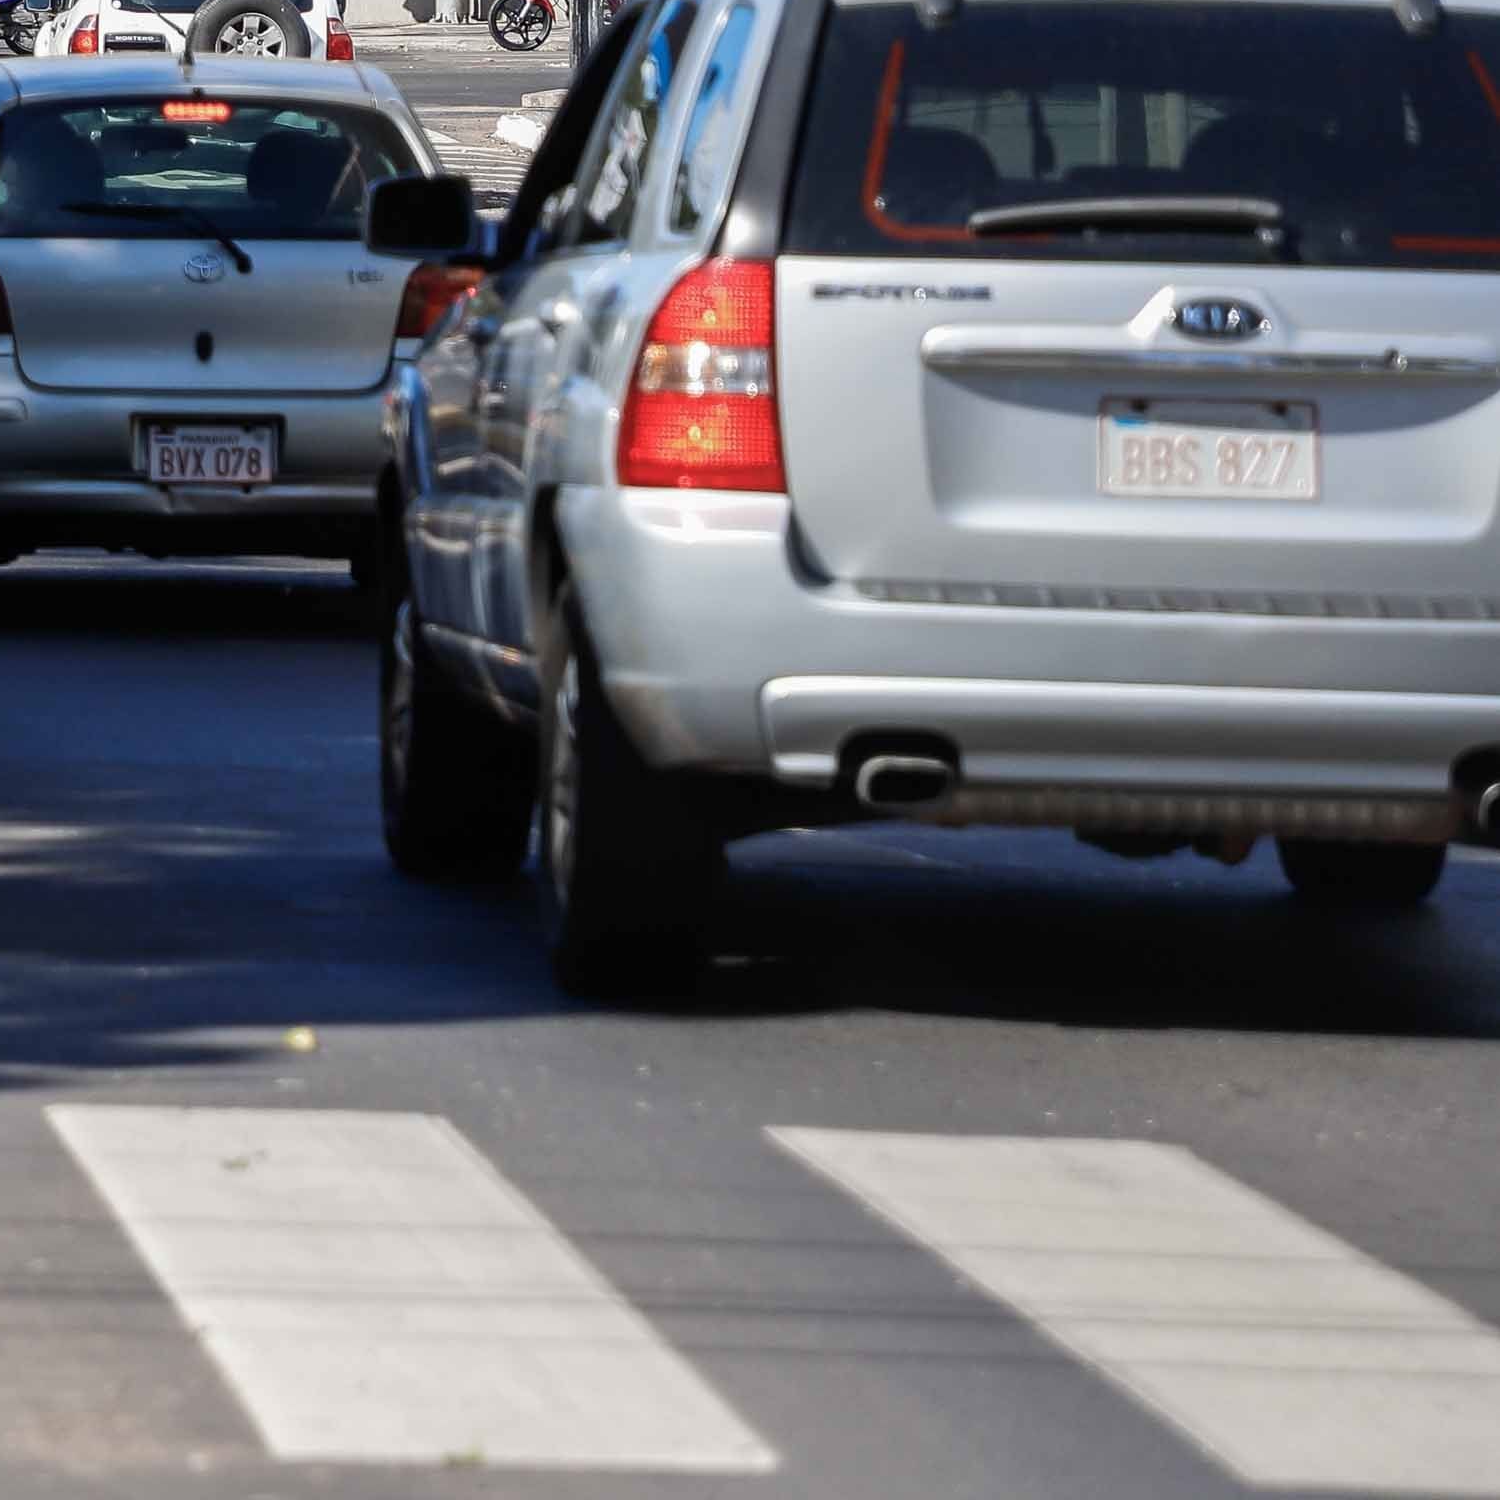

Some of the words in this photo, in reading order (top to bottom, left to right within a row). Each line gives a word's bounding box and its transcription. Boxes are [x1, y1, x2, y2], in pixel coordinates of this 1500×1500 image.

[160, 446, 206, 477] BVX
[214, 446, 262, 477] 078
[1121, 435, 1200, 485] BBS
[1215, 436, 1297, 486] 827
